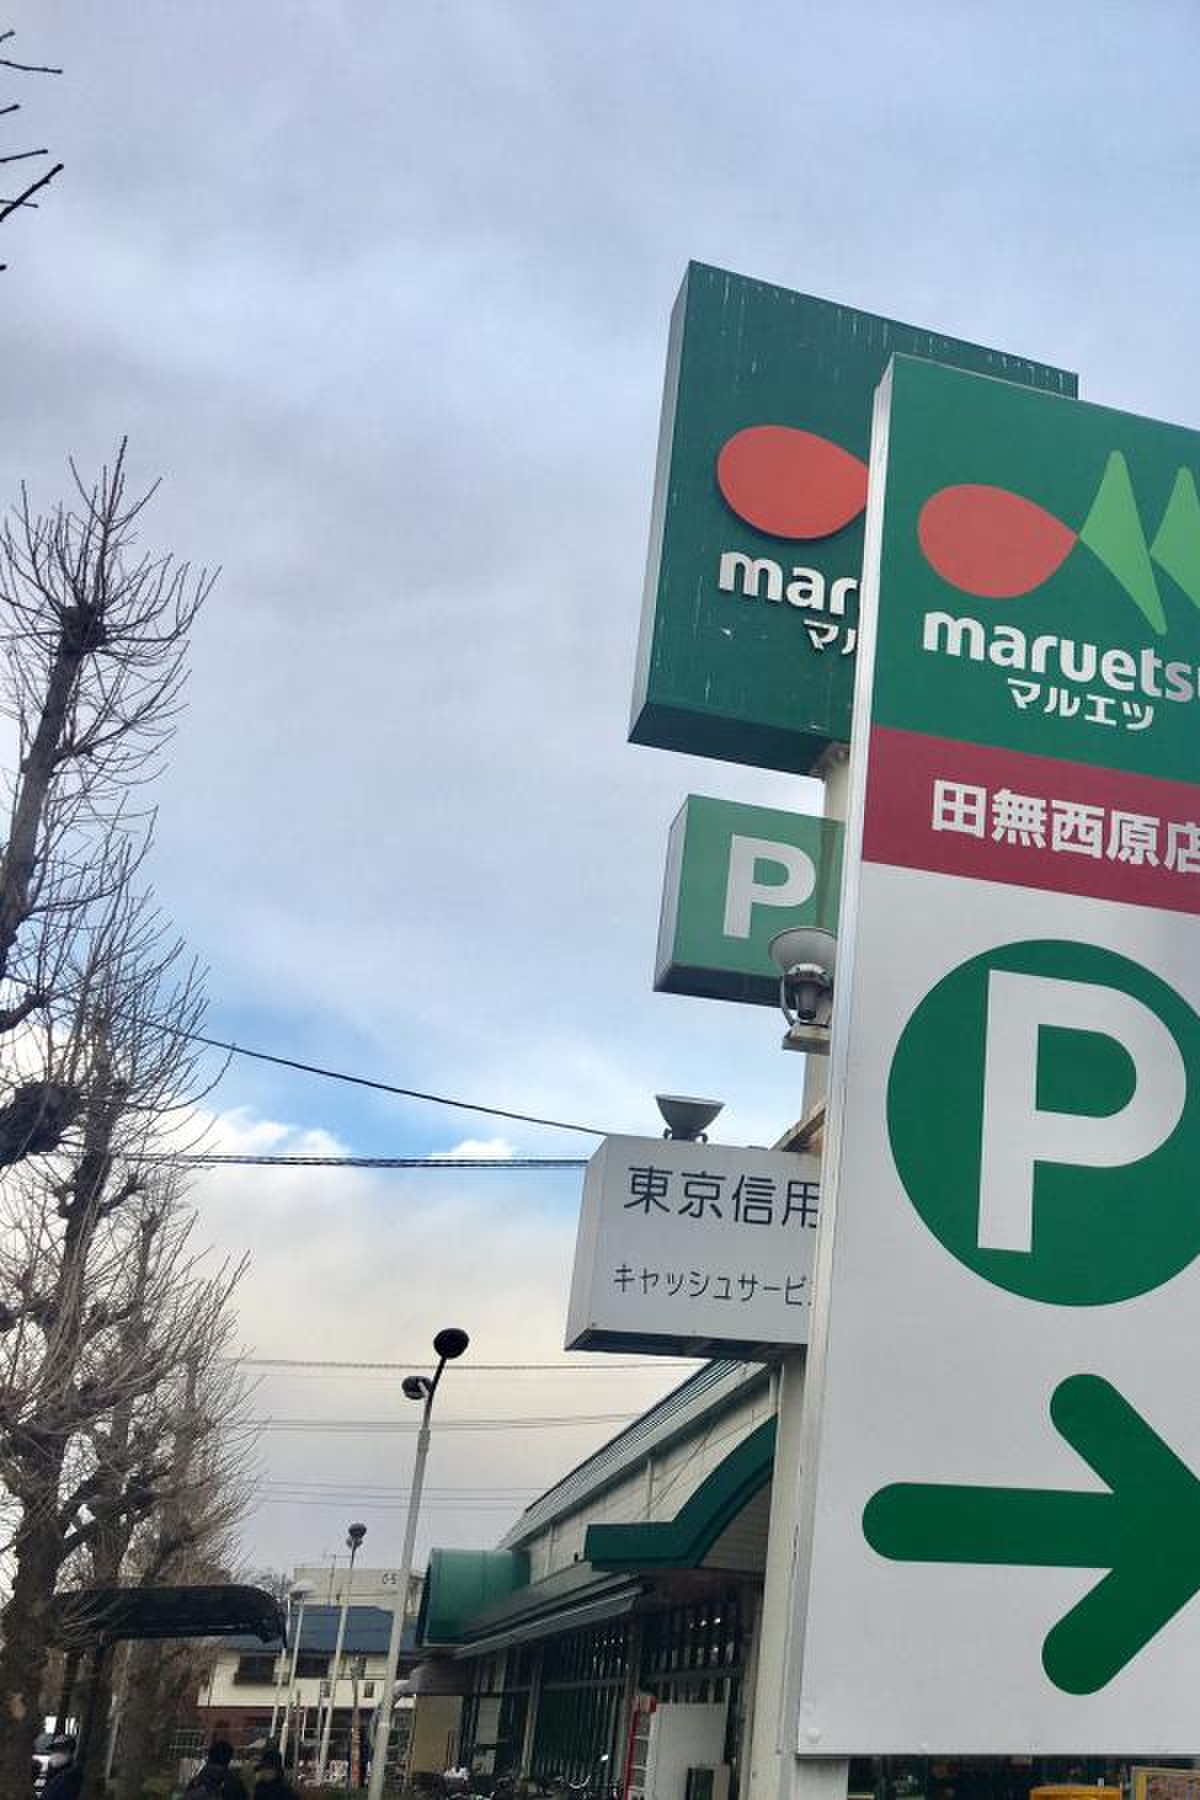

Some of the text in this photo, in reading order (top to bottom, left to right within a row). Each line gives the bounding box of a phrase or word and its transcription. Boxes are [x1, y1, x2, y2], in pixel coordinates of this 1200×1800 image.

[719, 551, 859, 616] mar
[1006, 677, 1155, 731] マルエツ
[723, 833, 817, 939] P
[977, 969, 1187, 1253] P
[623, 1165, 820, 1229] 東京信用
[613, 1263, 813, 1307] キャッシュサービ
